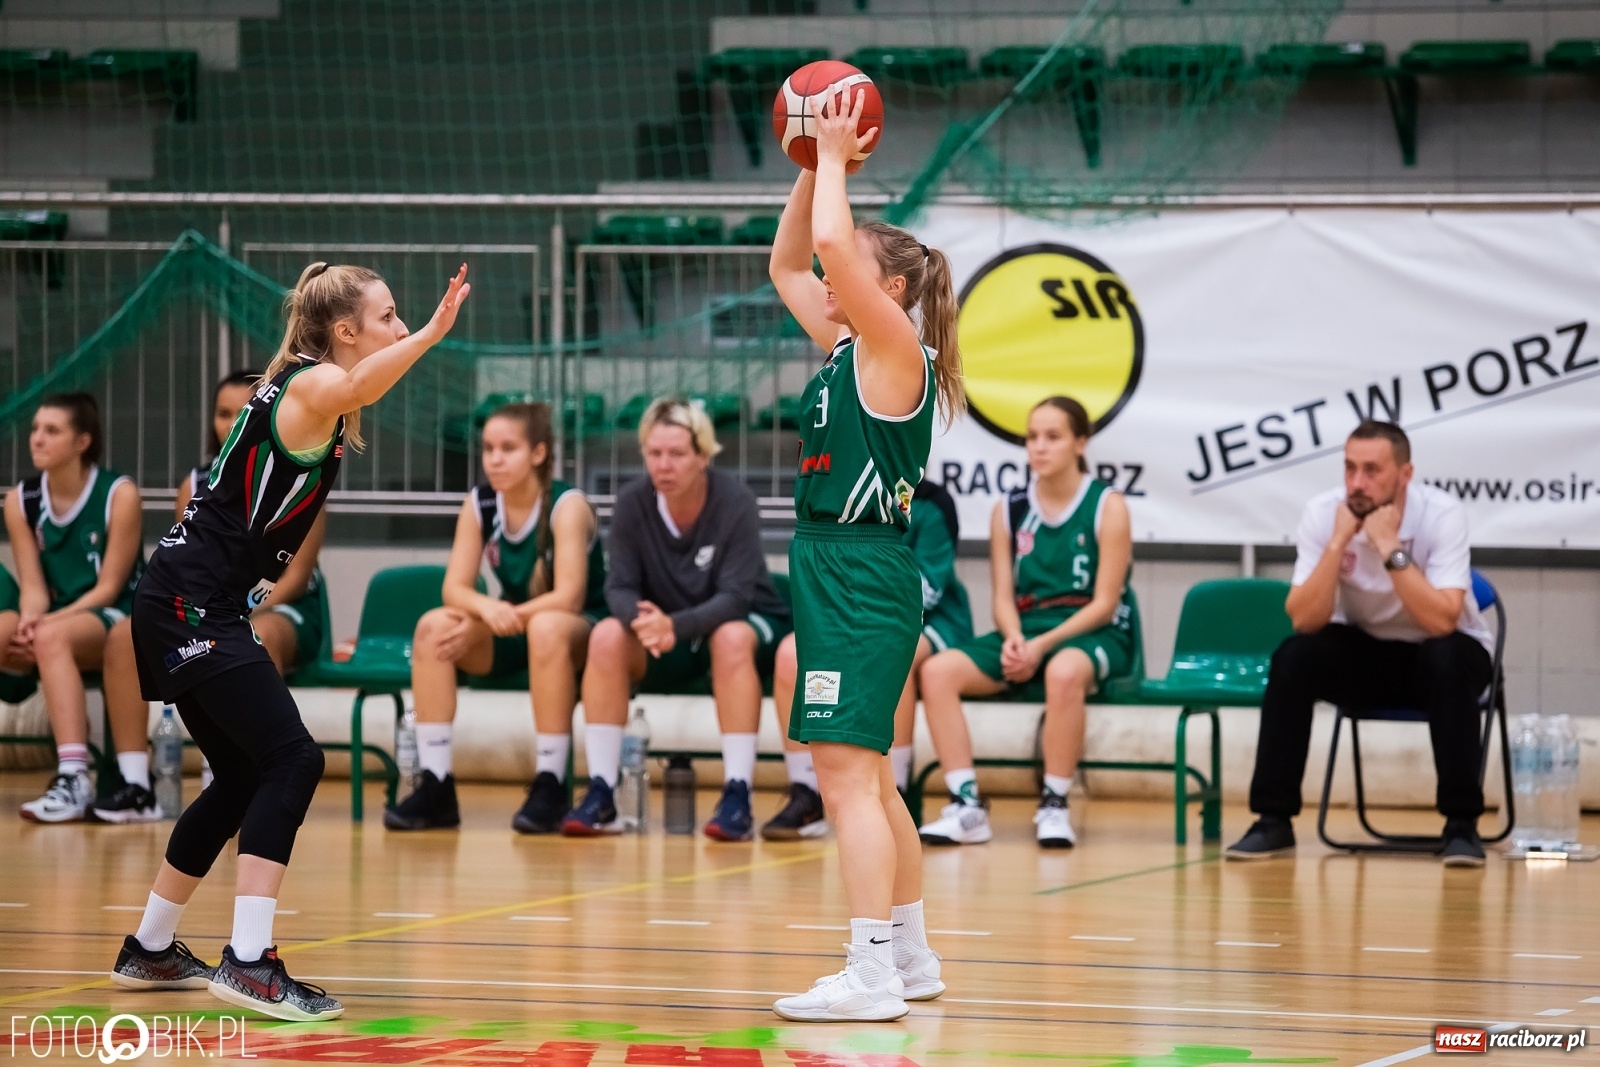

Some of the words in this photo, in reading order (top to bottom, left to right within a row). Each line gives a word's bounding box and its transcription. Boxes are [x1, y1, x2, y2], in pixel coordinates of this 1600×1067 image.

[813, 386, 829, 428] 3
[1187, 400, 1327, 482] JEST
[1345, 376, 1402, 421] W
[1422, 321, 1600, 411] PORZ
[941, 461, 1147, 498] RACIRZ
[1072, 554, 1089, 590] 5
